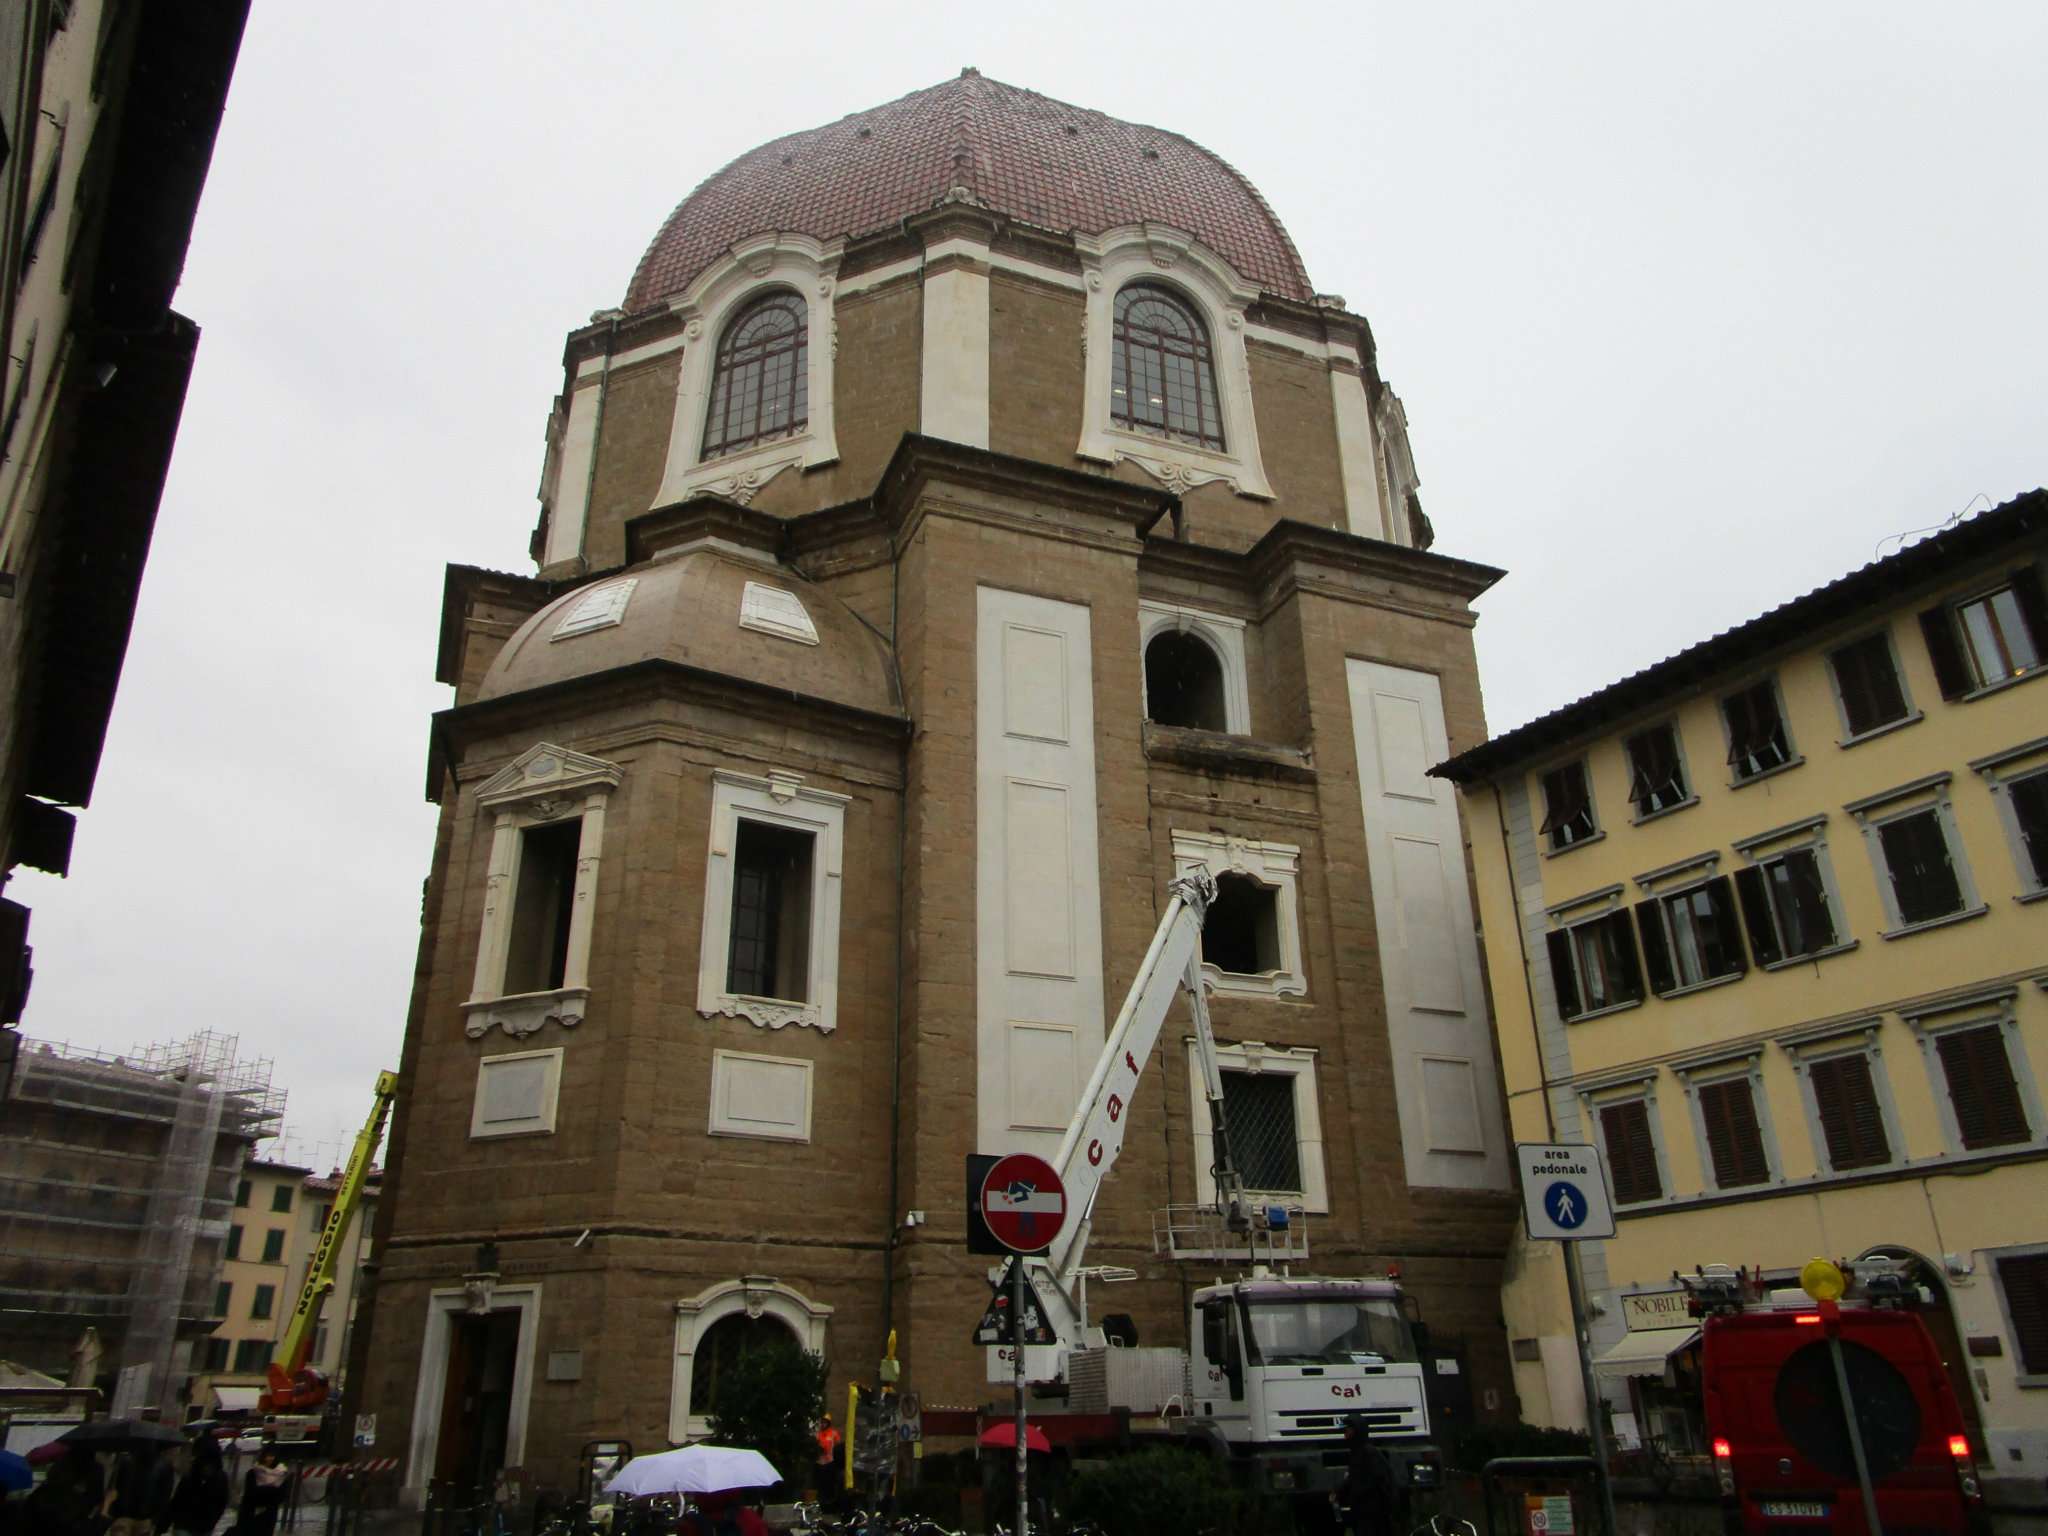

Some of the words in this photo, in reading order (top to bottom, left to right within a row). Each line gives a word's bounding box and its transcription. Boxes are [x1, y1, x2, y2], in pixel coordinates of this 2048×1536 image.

[1544, 1150, 1570, 1160] area
[1532, 1163, 1588, 1176] pedonale
[297, 1209, 342, 1316] NOLEGGIO
[1330, 1384, 1362, 1398] caf
